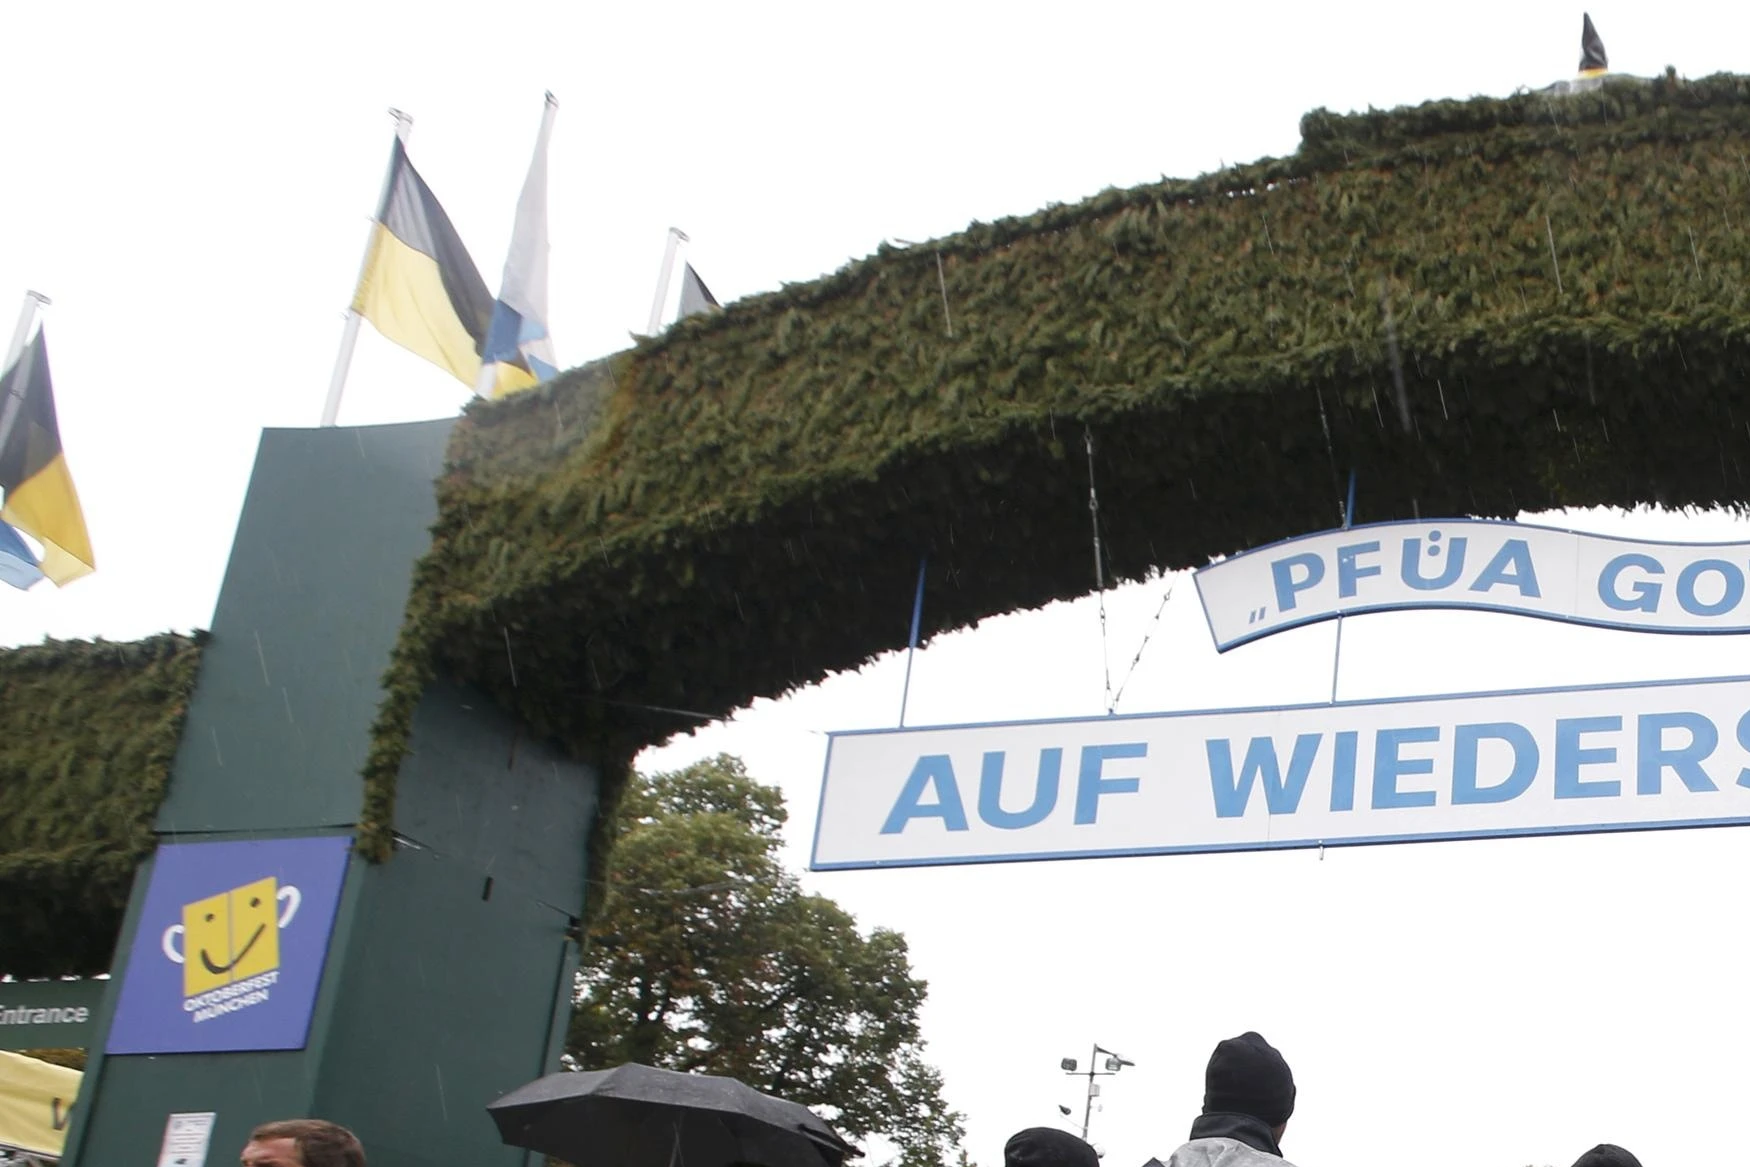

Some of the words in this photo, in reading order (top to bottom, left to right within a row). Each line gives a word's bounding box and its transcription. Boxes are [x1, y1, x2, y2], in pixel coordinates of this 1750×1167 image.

[879, 742, 1149, 834] AUF
[183, 970, 280, 1012] OKTOBERFEST
[193, 988, 269, 1023] MÜNCHEN
